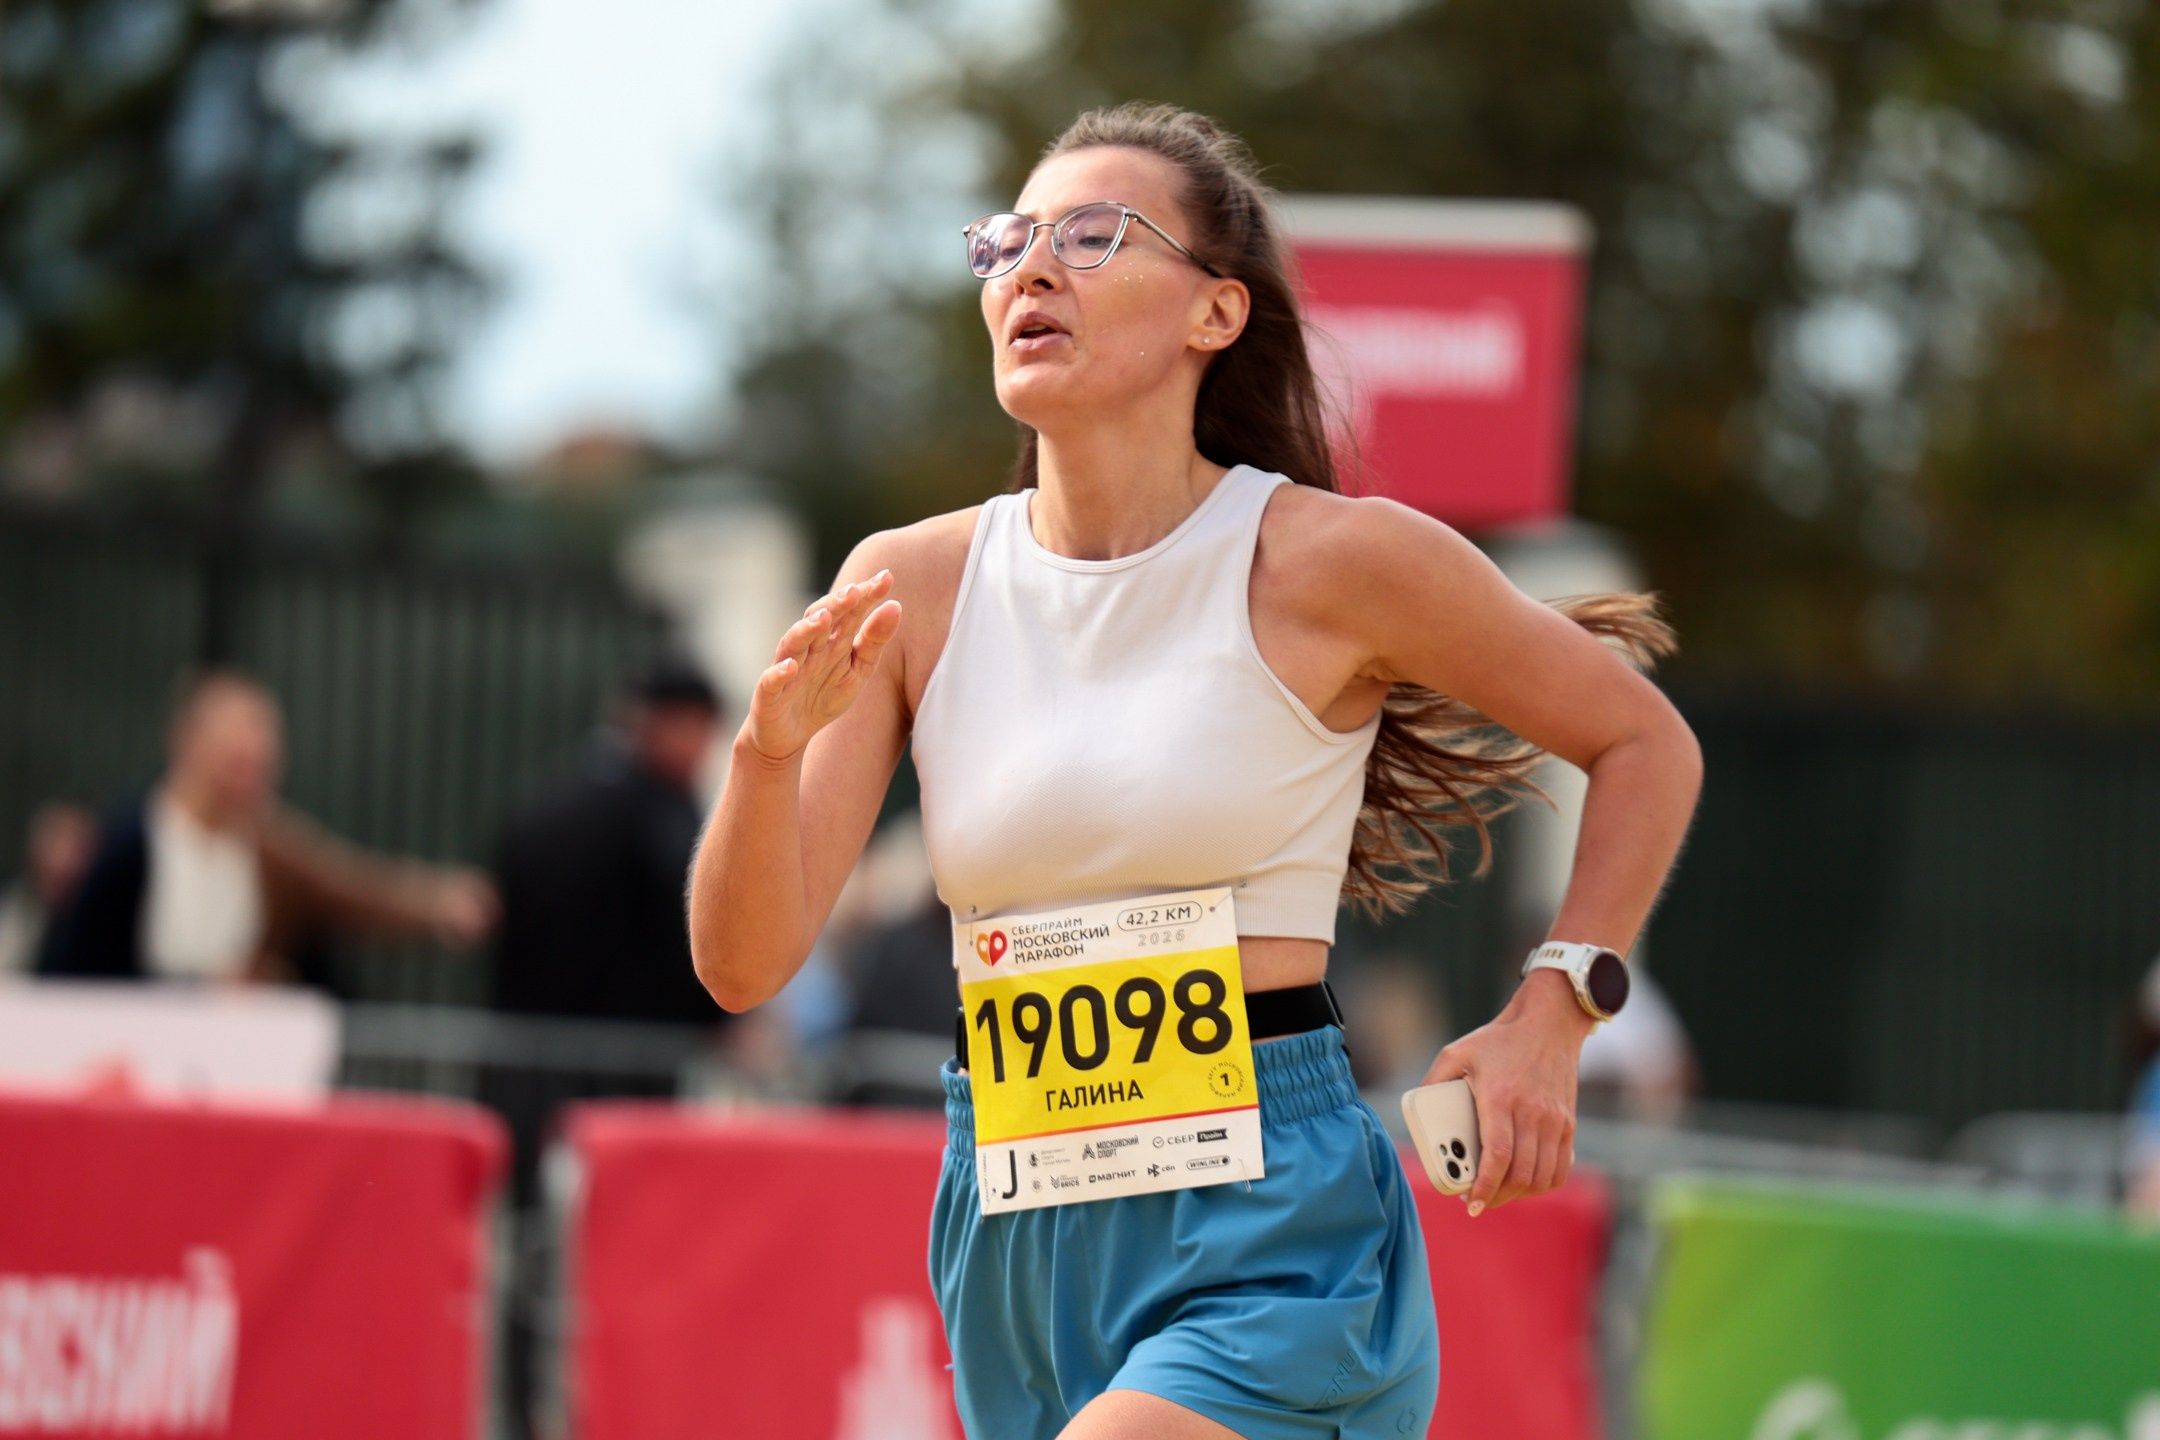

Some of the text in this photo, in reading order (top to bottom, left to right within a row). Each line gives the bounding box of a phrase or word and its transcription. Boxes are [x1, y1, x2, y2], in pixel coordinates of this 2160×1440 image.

[1126, 906, 1191, 926] 42,2 КМ
[1011, 917, 1083, 936] СБЕРПРАЙМ
[1013, 923, 1110, 950] МОСКОВСКИЙ
[1138, 929, 1185, 947] 2026
[1015, 943, 1085, 964] МАРАФОН
[976, 968, 1233, 1084] 19098
[1219, 1072, 1229, 1087] 1
[1045, 1079, 1145, 1112] ГАЛИНА
[1096, 1134, 1139, 1149] МОСКОВСКИЙ
[1167, 1134, 1196, 1145] СБЕР
[1097, 1148, 1117, 1159] СПОРТ
[1190, 1159, 1220, 1168] WINLINE
[1002, 1149, 1018, 1200] J
[1060, 1179, 1080, 1188] BRICS
